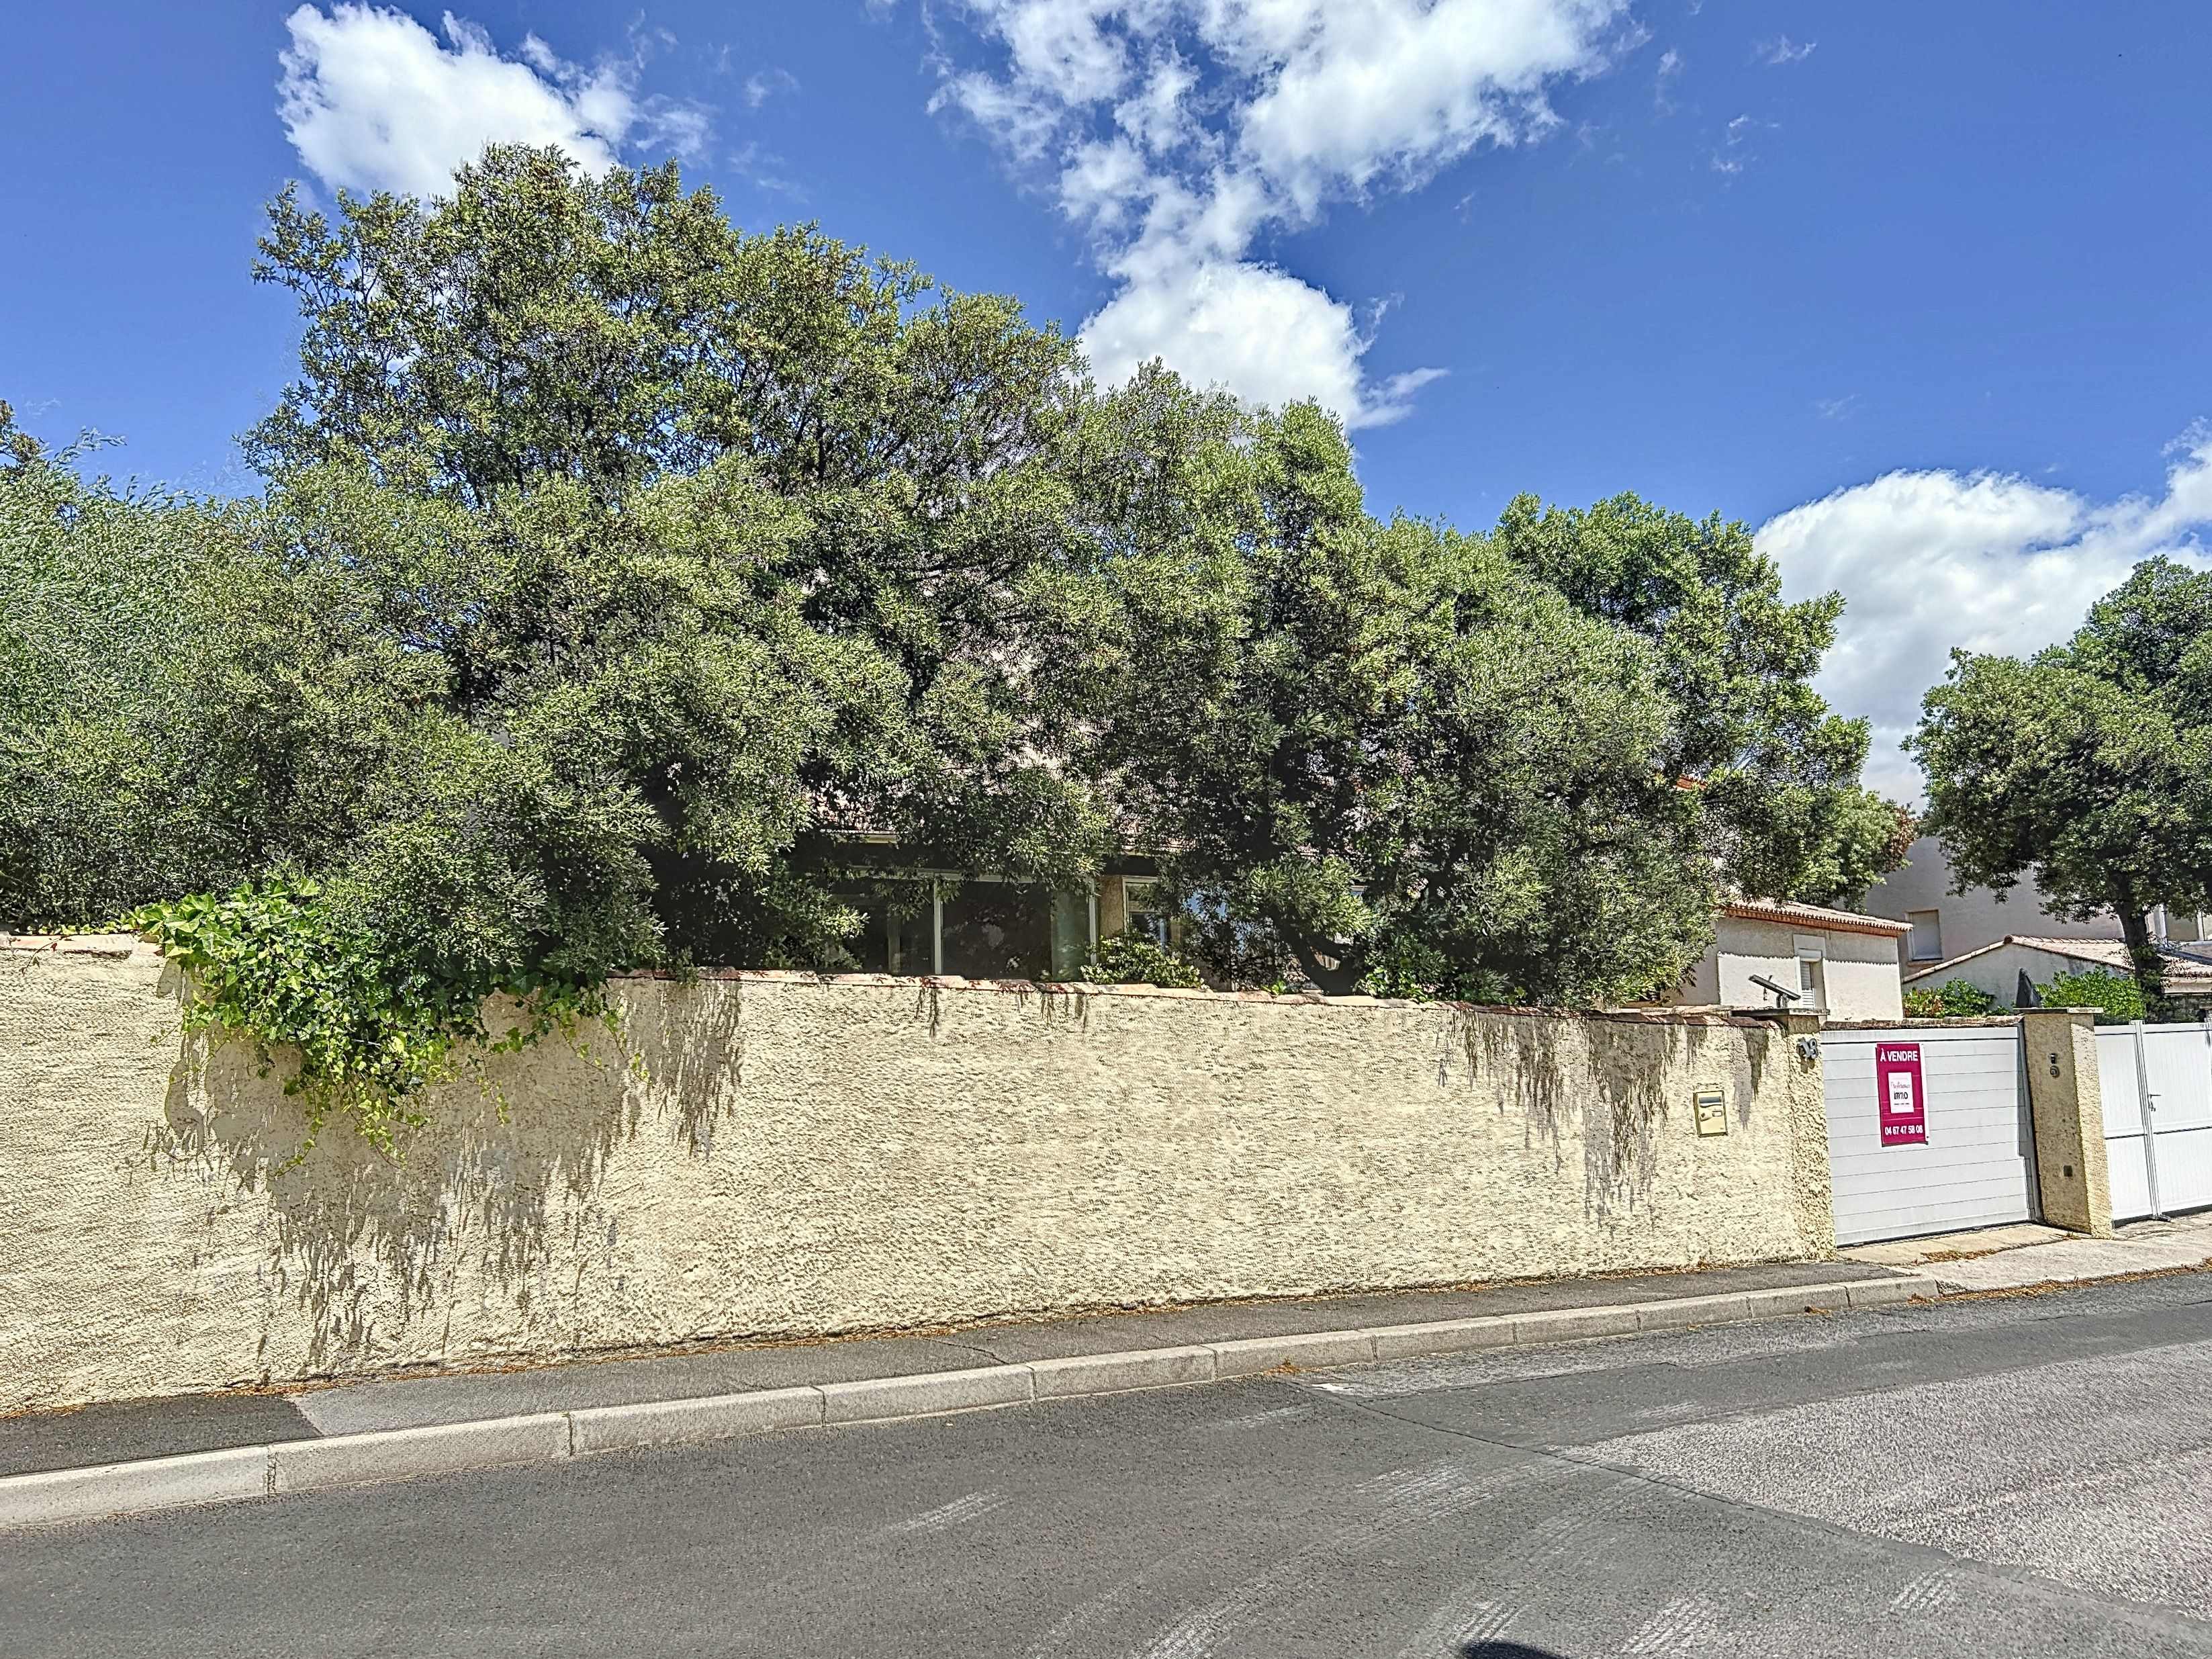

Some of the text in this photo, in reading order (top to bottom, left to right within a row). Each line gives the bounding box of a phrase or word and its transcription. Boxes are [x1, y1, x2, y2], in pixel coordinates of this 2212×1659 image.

[1880, 1048, 1918, 1061] À VENDRE
[1885, 1126, 1892, 1135] 04
[1893, 1126, 1899, 1134] 67
[1900, 1125, 1906, 1134] 47
